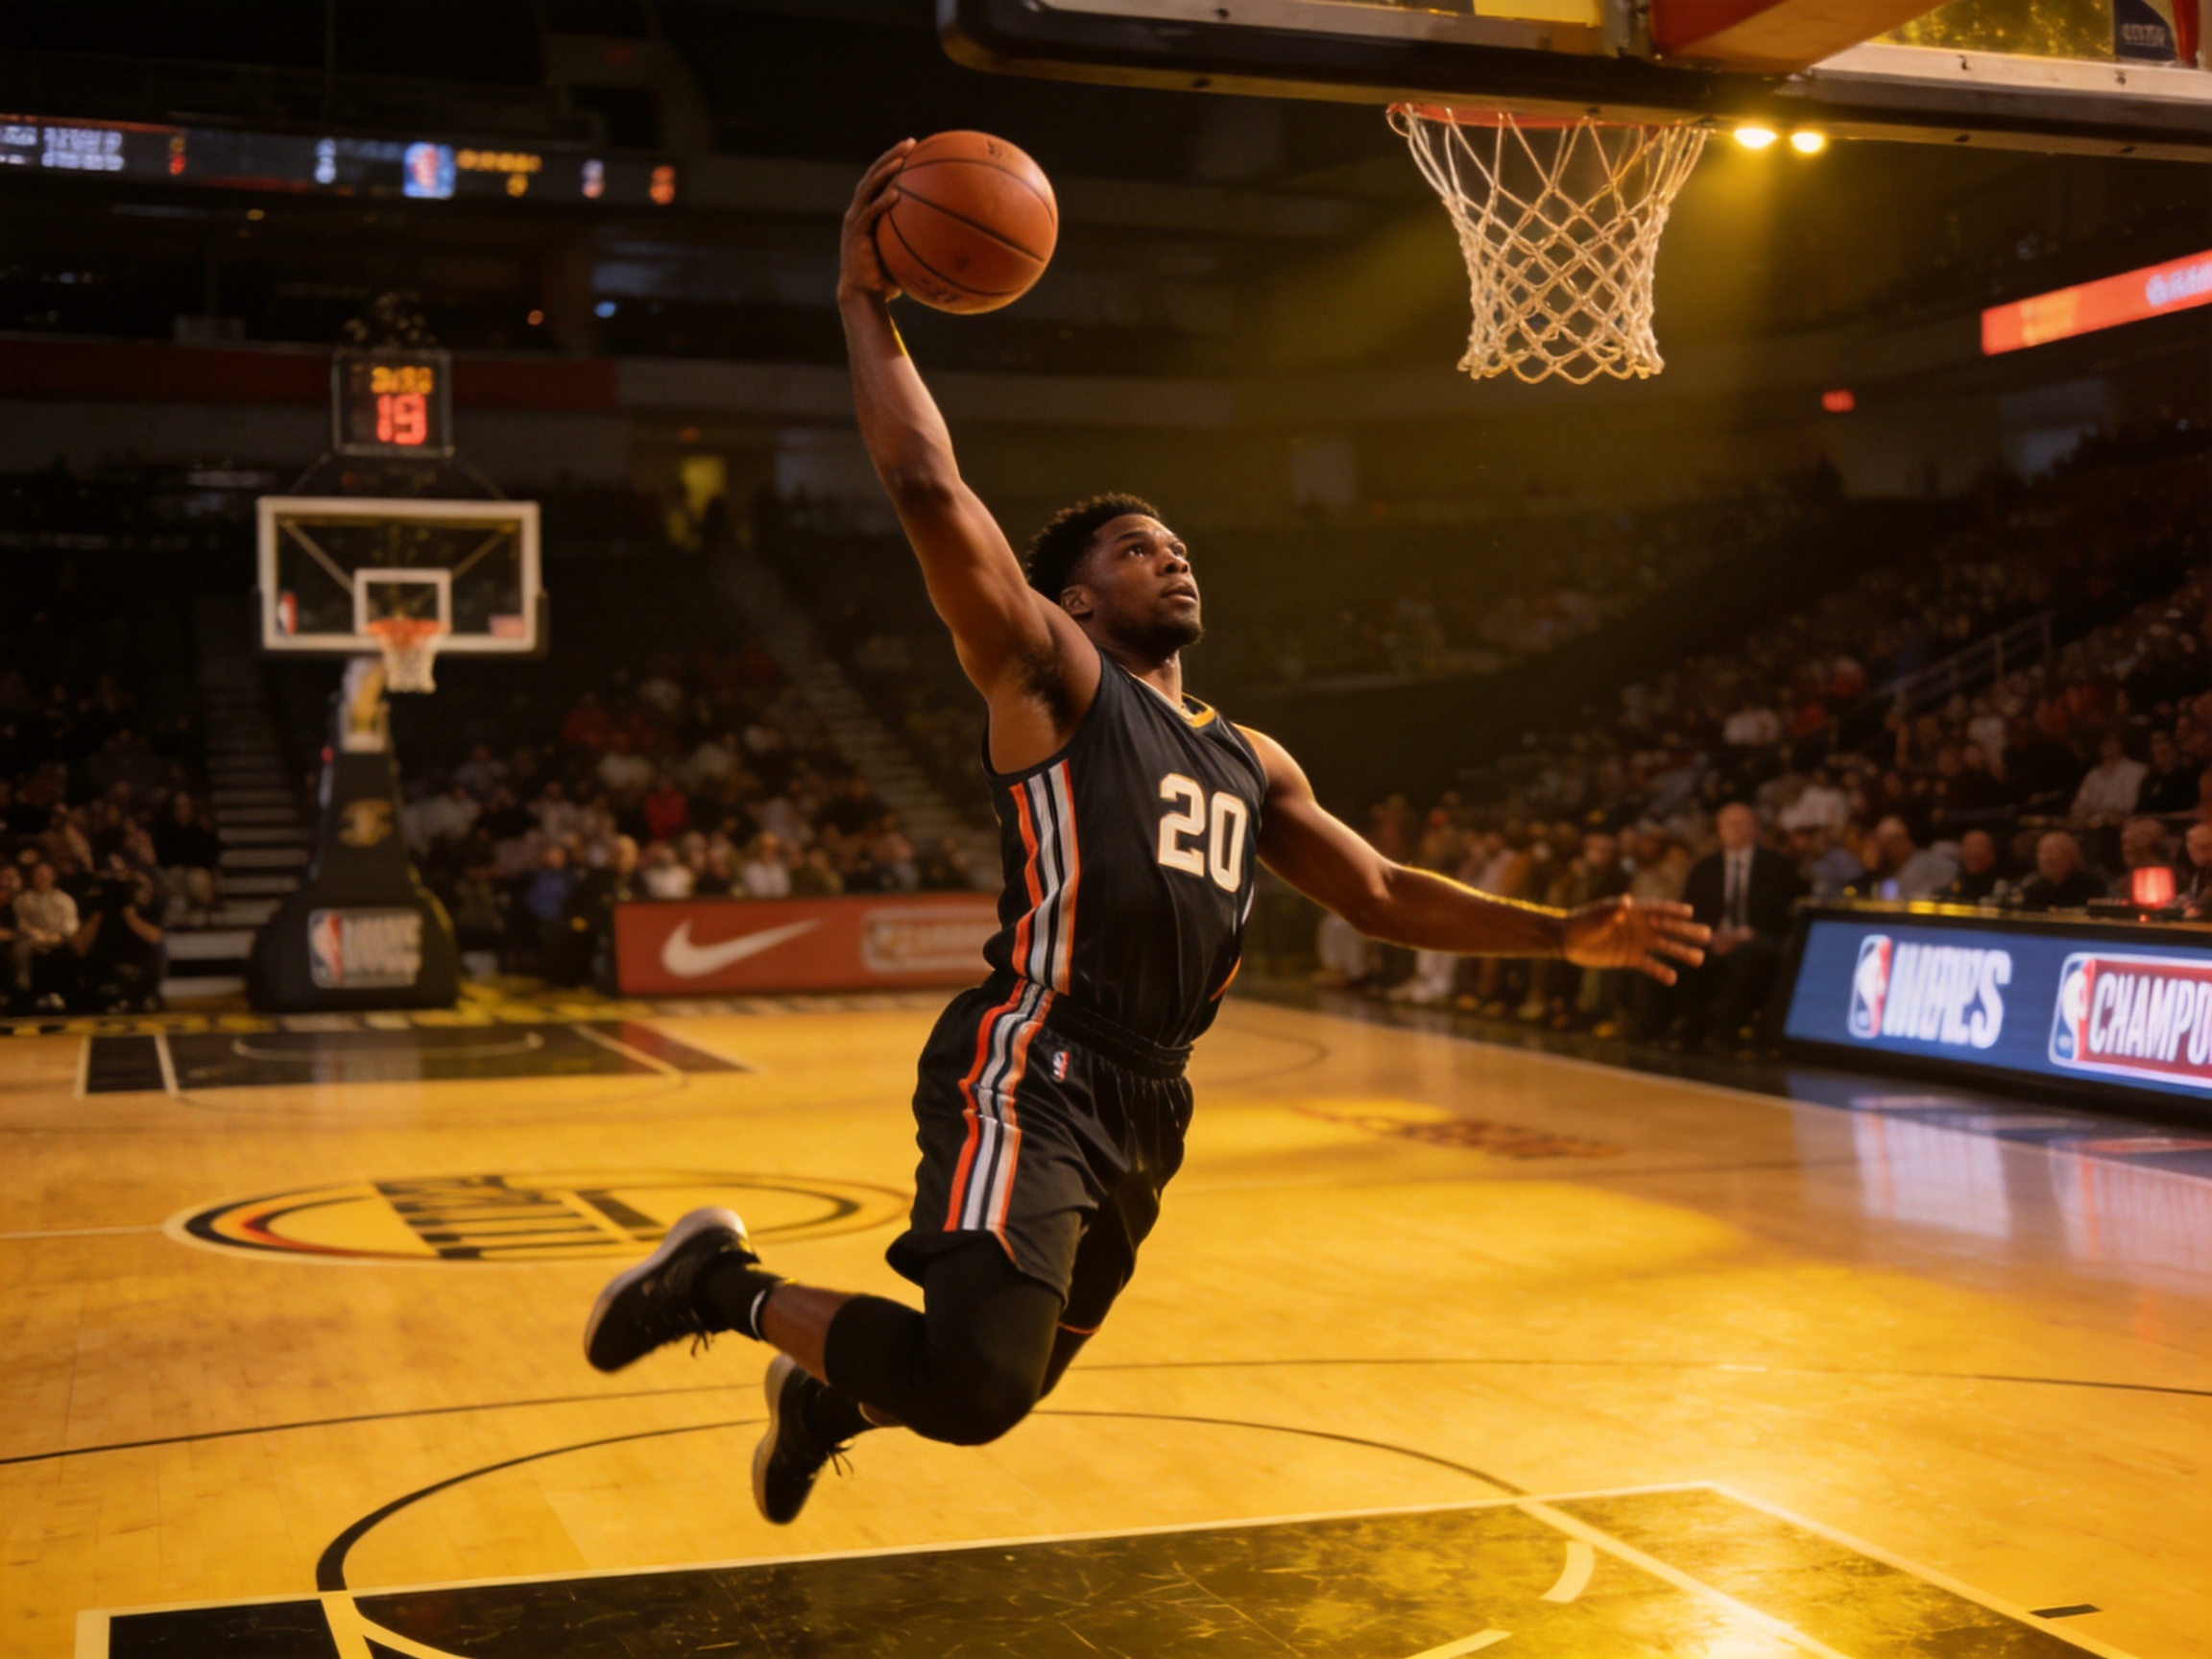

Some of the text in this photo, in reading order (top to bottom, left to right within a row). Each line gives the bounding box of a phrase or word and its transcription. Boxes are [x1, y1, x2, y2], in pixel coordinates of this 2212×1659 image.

[376, 393, 427, 445] 19
[1158, 773, 1247, 893] 20
[2089, 972, 2212, 1067] CHAMPO
